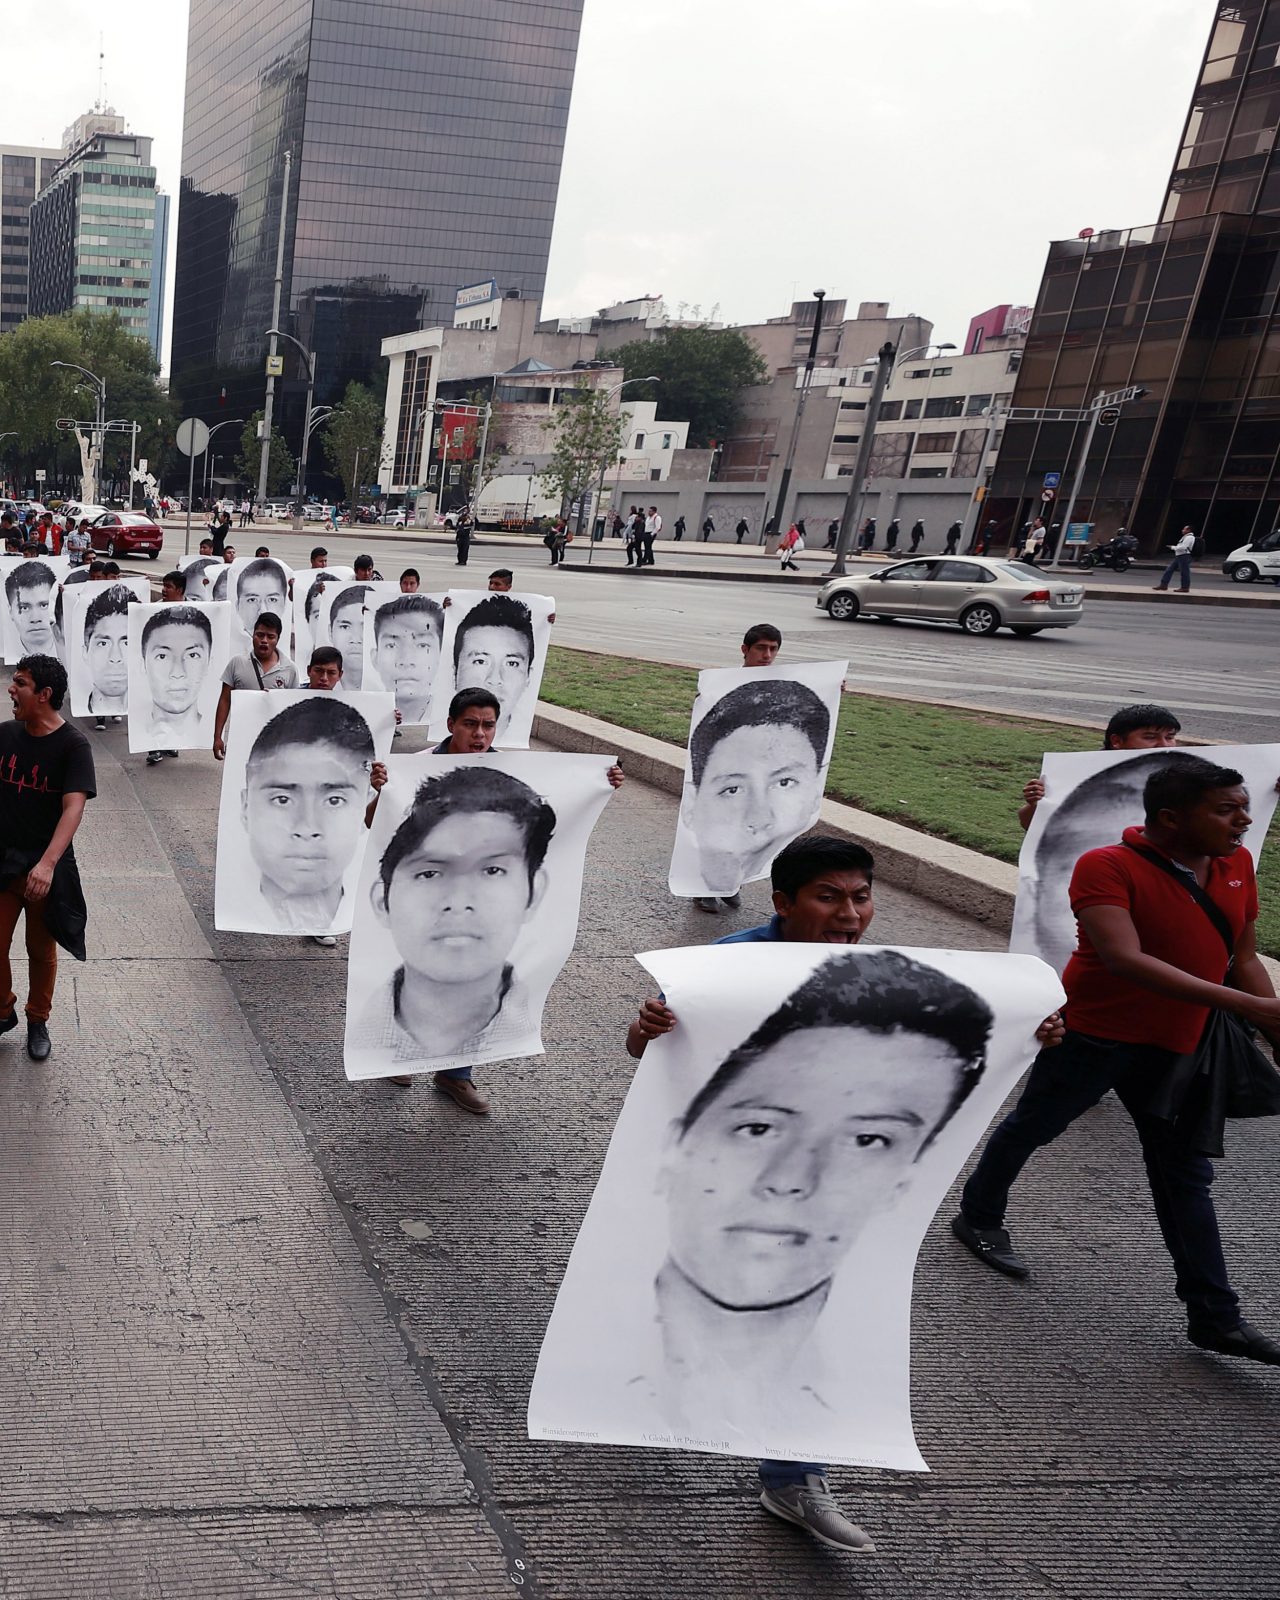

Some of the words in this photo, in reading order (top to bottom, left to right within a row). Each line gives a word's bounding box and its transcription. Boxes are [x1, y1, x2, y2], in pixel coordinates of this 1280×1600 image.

[648, 1434, 671, 1443] Global
[684, 1436, 709, 1447] Project
[710, 1439, 719, 1449] by
[721, 1440, 730, 1450] JR
